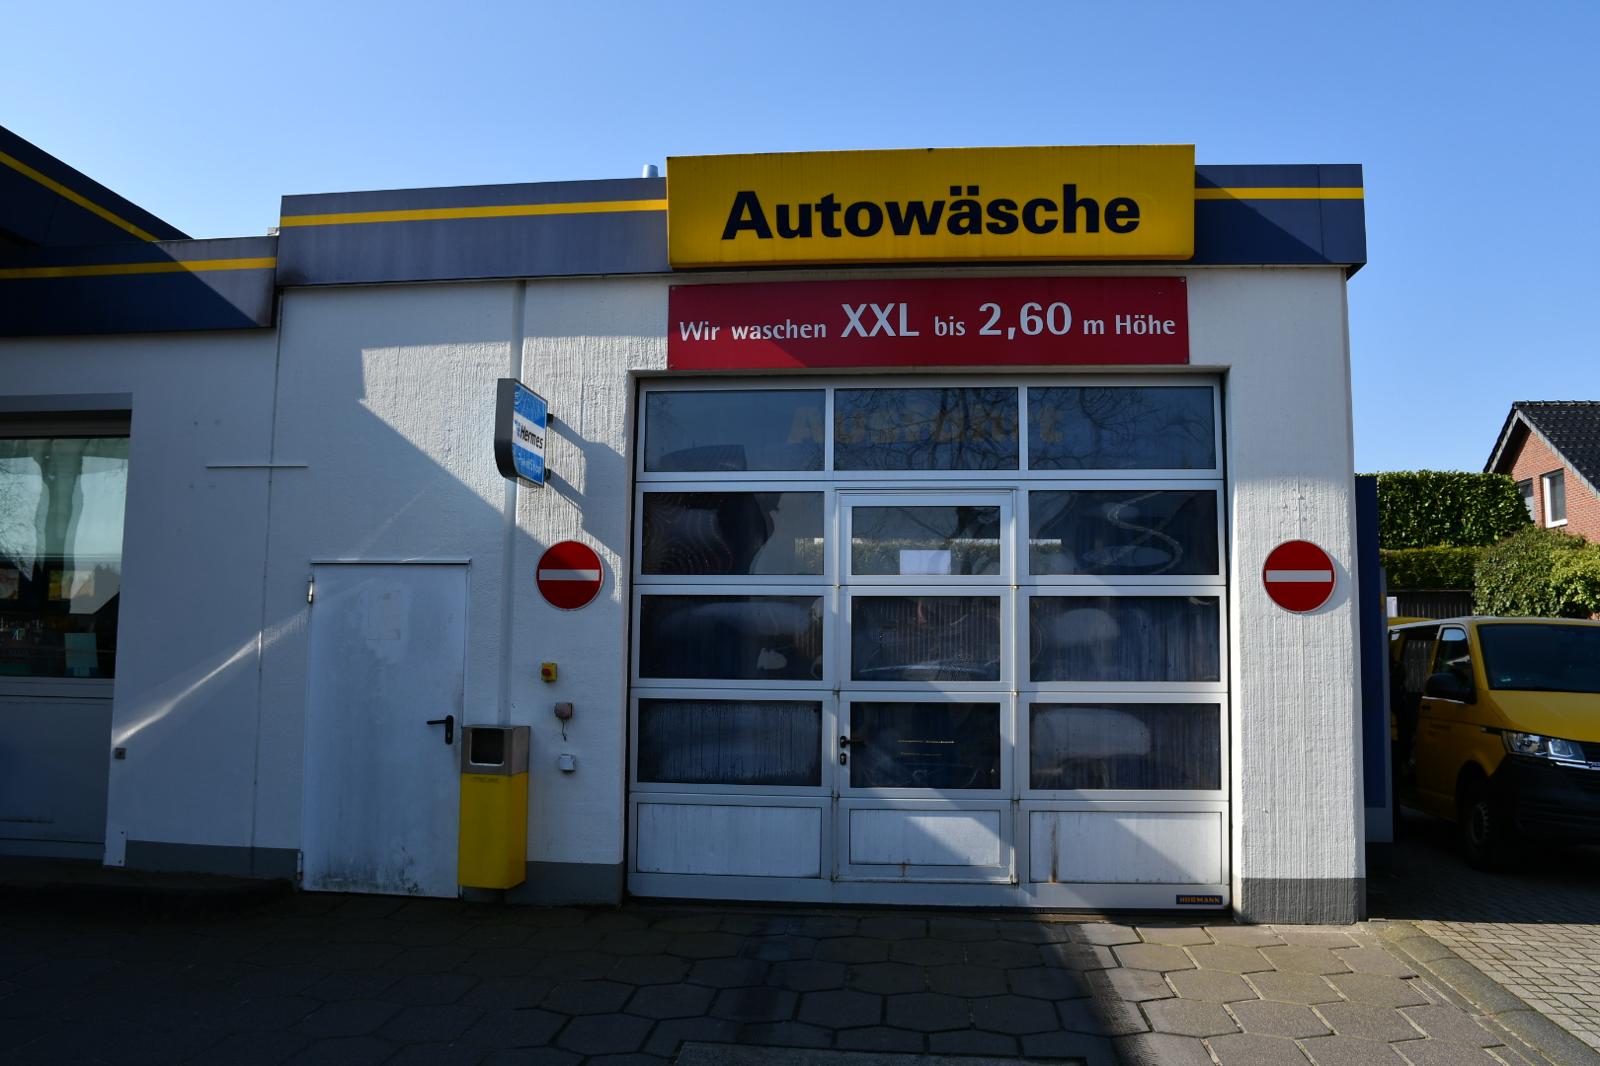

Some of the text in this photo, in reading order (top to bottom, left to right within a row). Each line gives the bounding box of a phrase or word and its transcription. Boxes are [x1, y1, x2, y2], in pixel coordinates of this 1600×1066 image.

[721, 183, 1141, 241] Autowäsche
[679, 302, 1176, 342] Wir waschen XXL bis 2,60 m Höhe
[520, 426, 544, 449] Hermes
